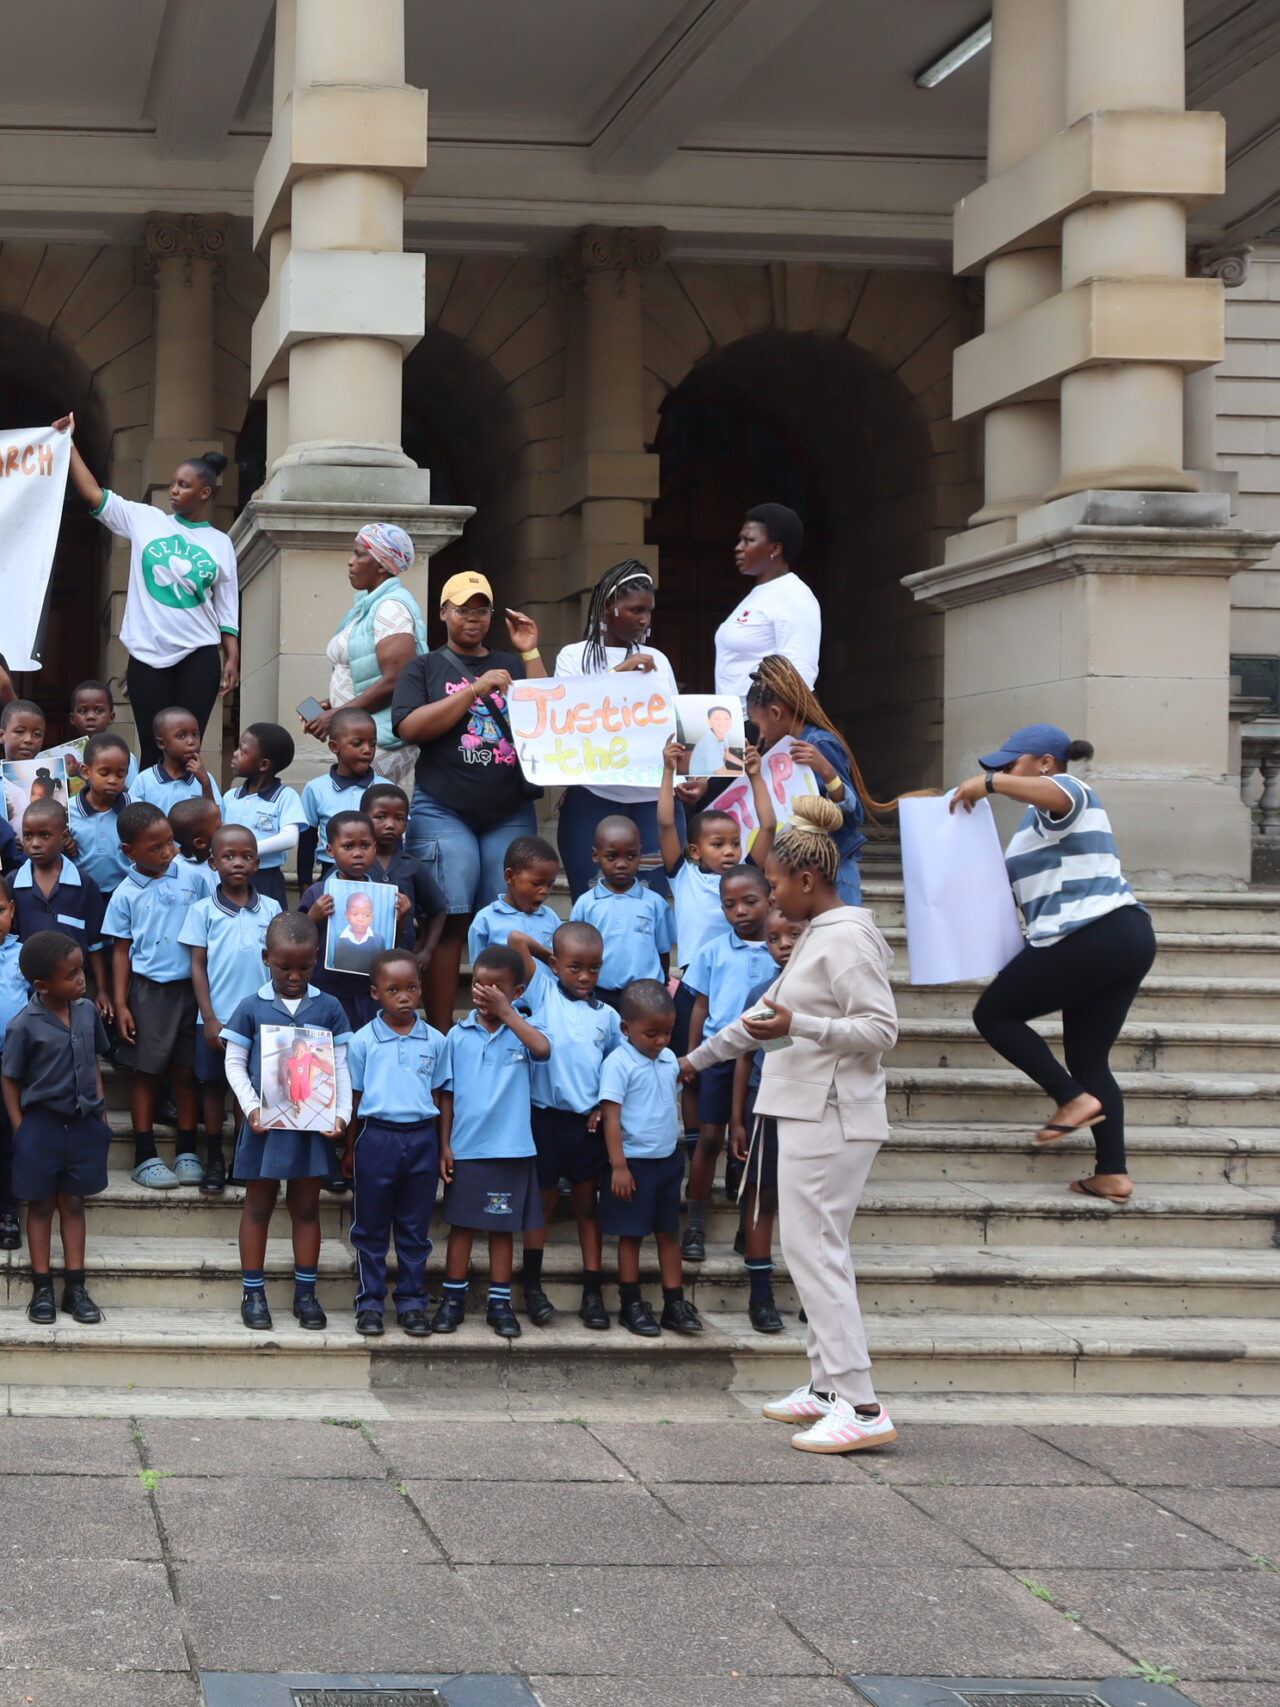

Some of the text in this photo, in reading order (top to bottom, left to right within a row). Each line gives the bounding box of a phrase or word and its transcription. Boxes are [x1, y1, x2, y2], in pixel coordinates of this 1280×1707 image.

[512, 684, 669, 739] Justice
[520, 742, 539, 774] 4
[543, 736, 630, 775] the
